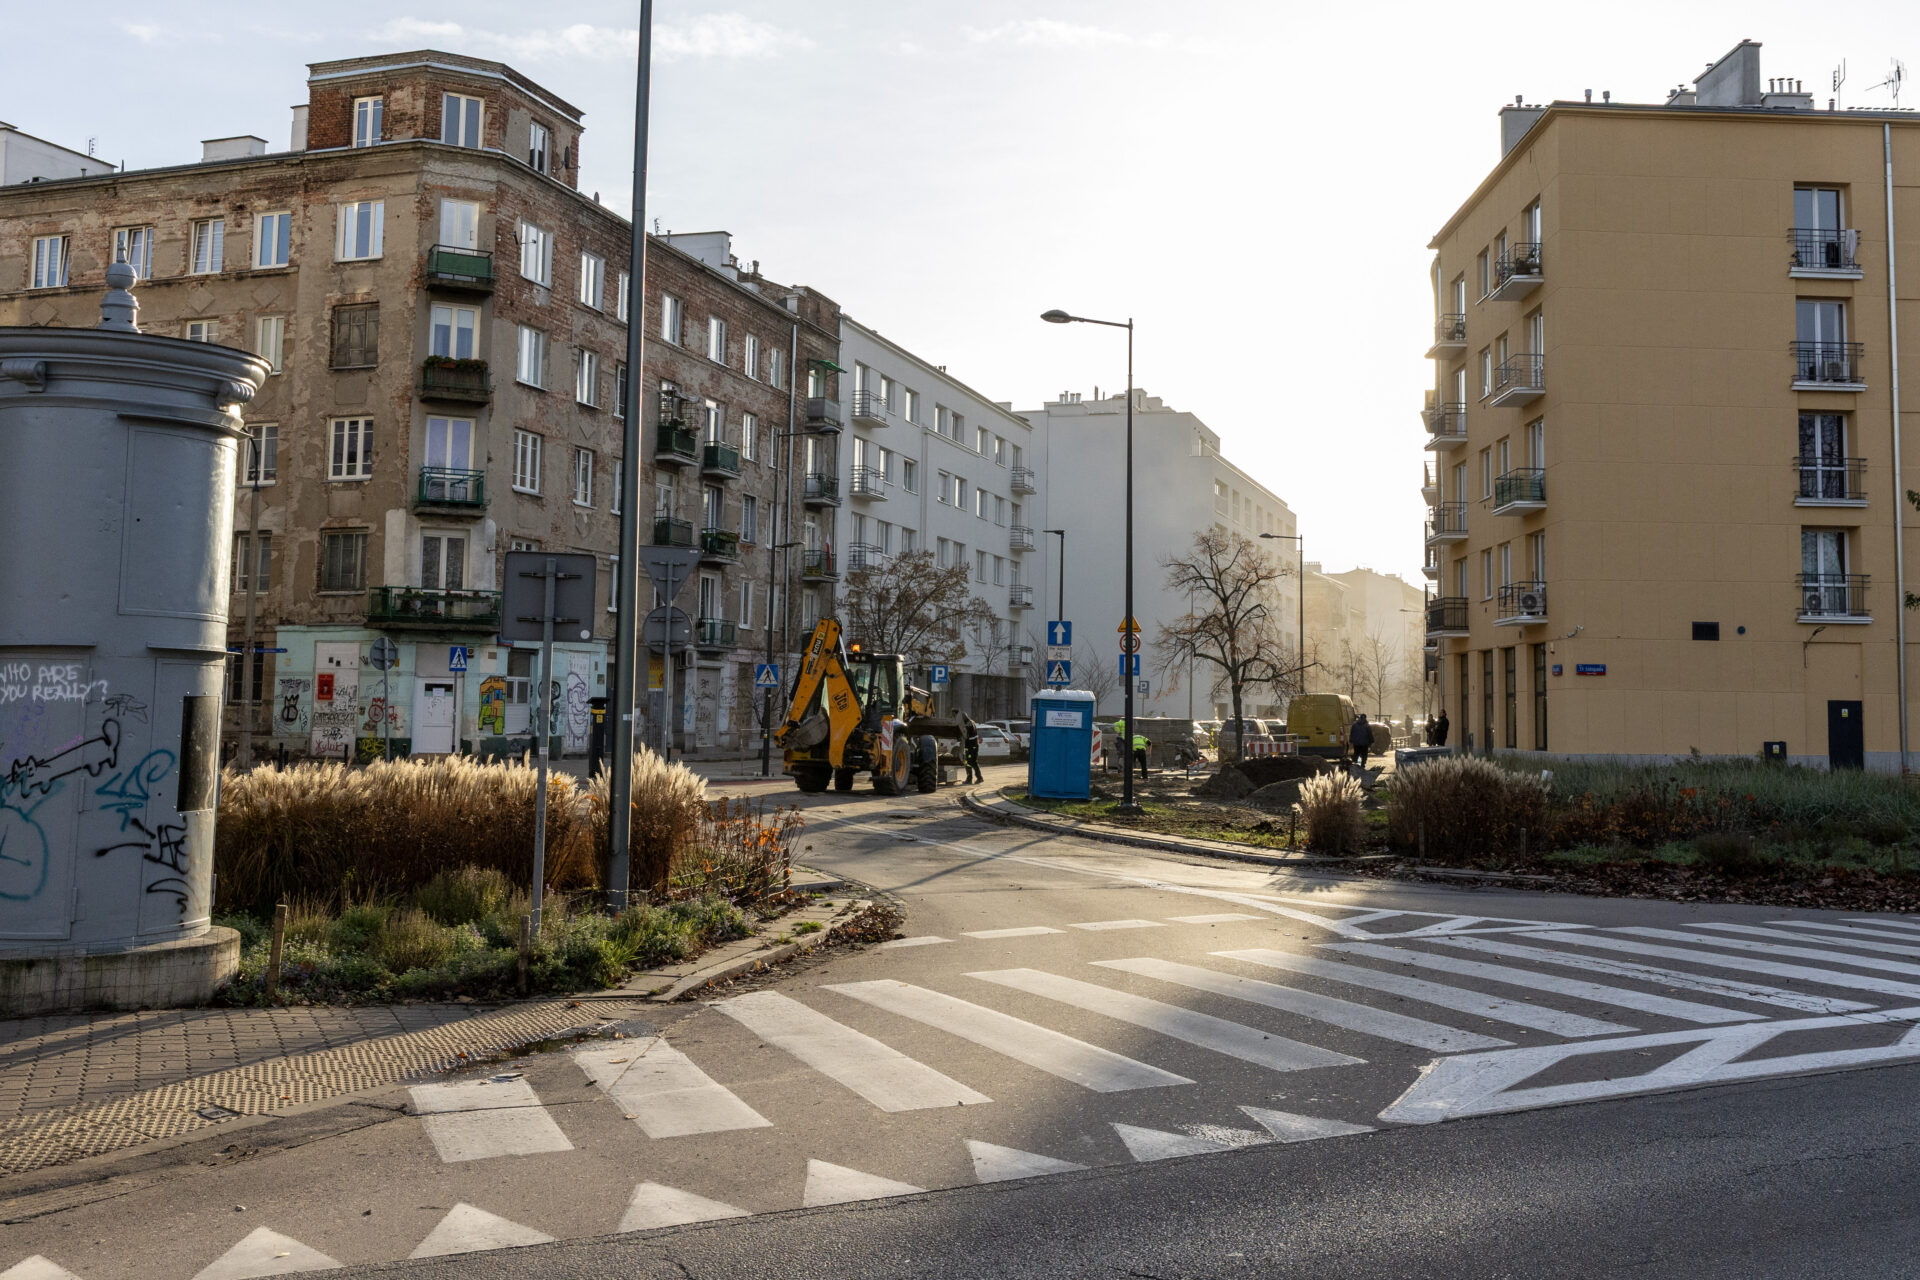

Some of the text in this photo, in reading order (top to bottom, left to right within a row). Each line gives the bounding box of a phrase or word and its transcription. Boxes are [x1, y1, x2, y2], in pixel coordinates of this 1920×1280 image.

[38, 664, 83, 685] ARE
[0, 684, 28, 704] YOU
[834, 692, 848, 711] JCB
